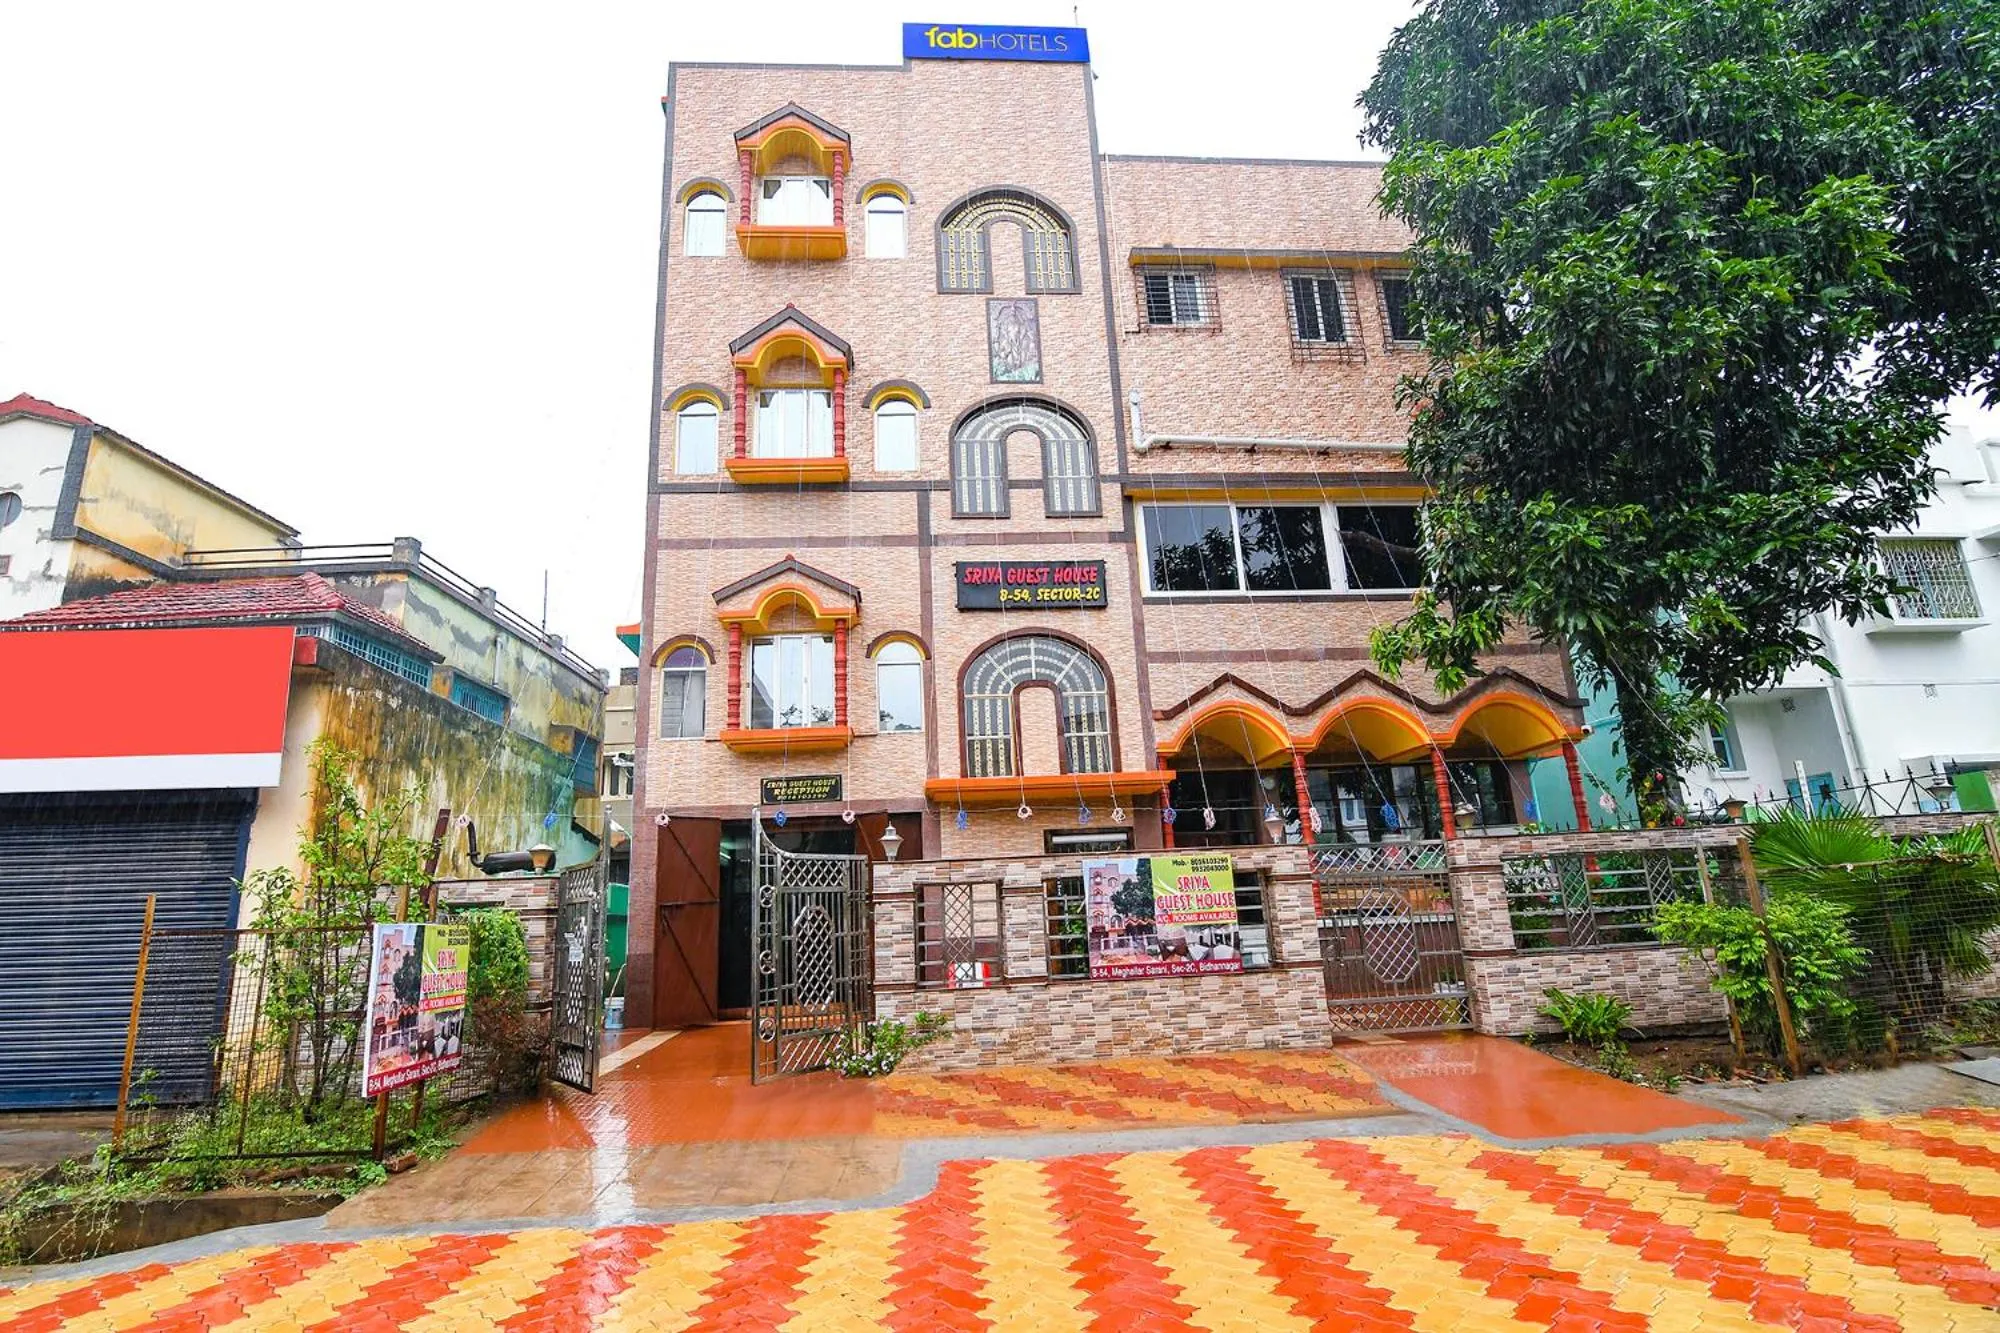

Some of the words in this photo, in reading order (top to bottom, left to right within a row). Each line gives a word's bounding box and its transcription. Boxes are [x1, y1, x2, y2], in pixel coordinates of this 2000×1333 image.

[963, 567, 1002, 585] SRIYA
[1007, 567, 1050, 585] GUEST
[1053, 566, 1099, 584] HOUSE
[1036, 587, 1101, 602] SECTOR-2C
[766, 780, 788, 789] SRIYA
[789, 779, 812, 787] GUEST
[812, 778, 837, 786] HOUSE
[773, 786, 830, 796] RECEPTION
[1176, 875, 1211, 890] SRIYA
[1156, 894, 1191, 909] GUEST
[1195, 892, 1234, 908] HOUSE
